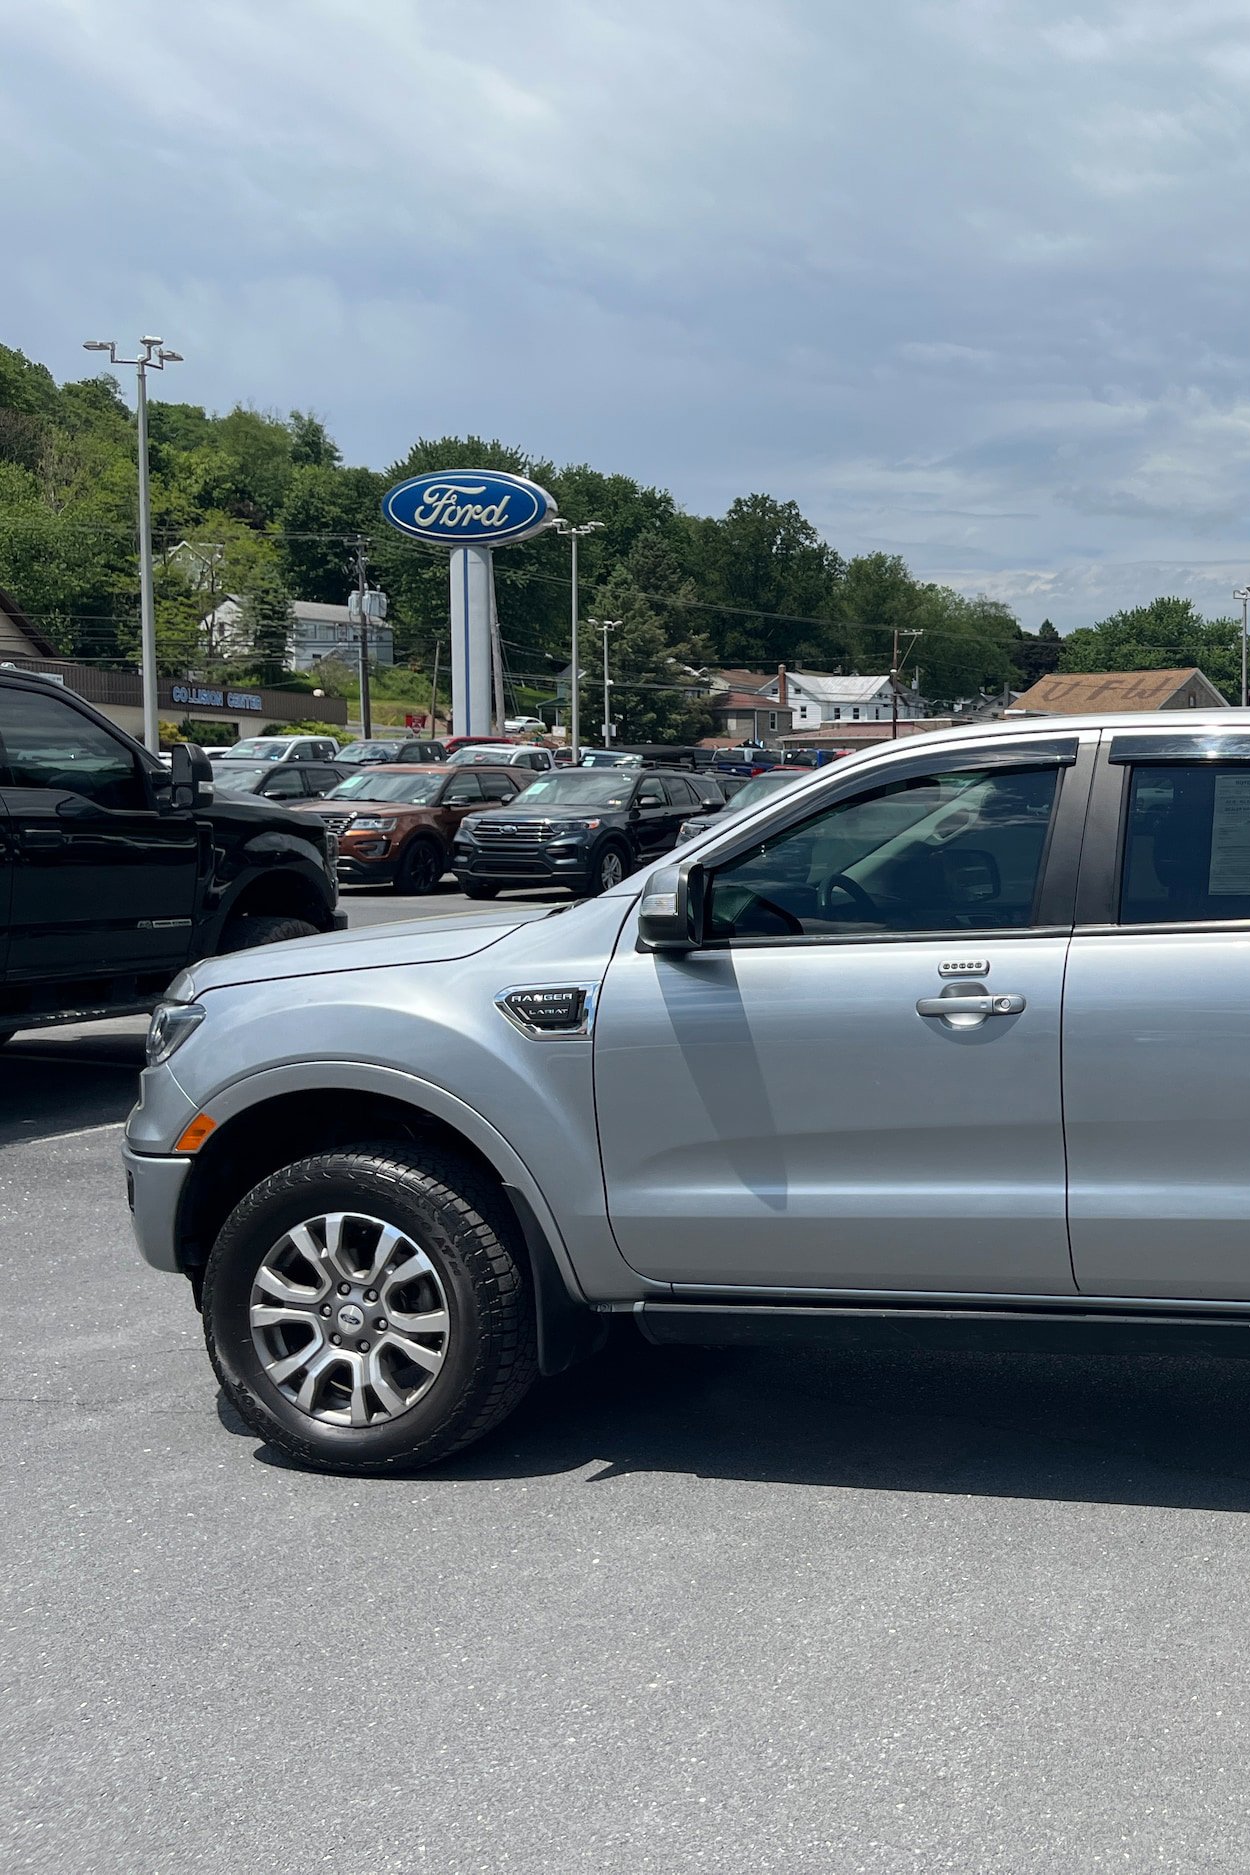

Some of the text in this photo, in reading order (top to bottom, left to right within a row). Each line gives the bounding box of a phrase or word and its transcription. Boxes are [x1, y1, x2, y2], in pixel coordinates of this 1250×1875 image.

[414, 484, 512, 527] Ford
[172, 686, 263, 710] COLLISION CENTER
[511, 993, 573, 1002] RANGER
